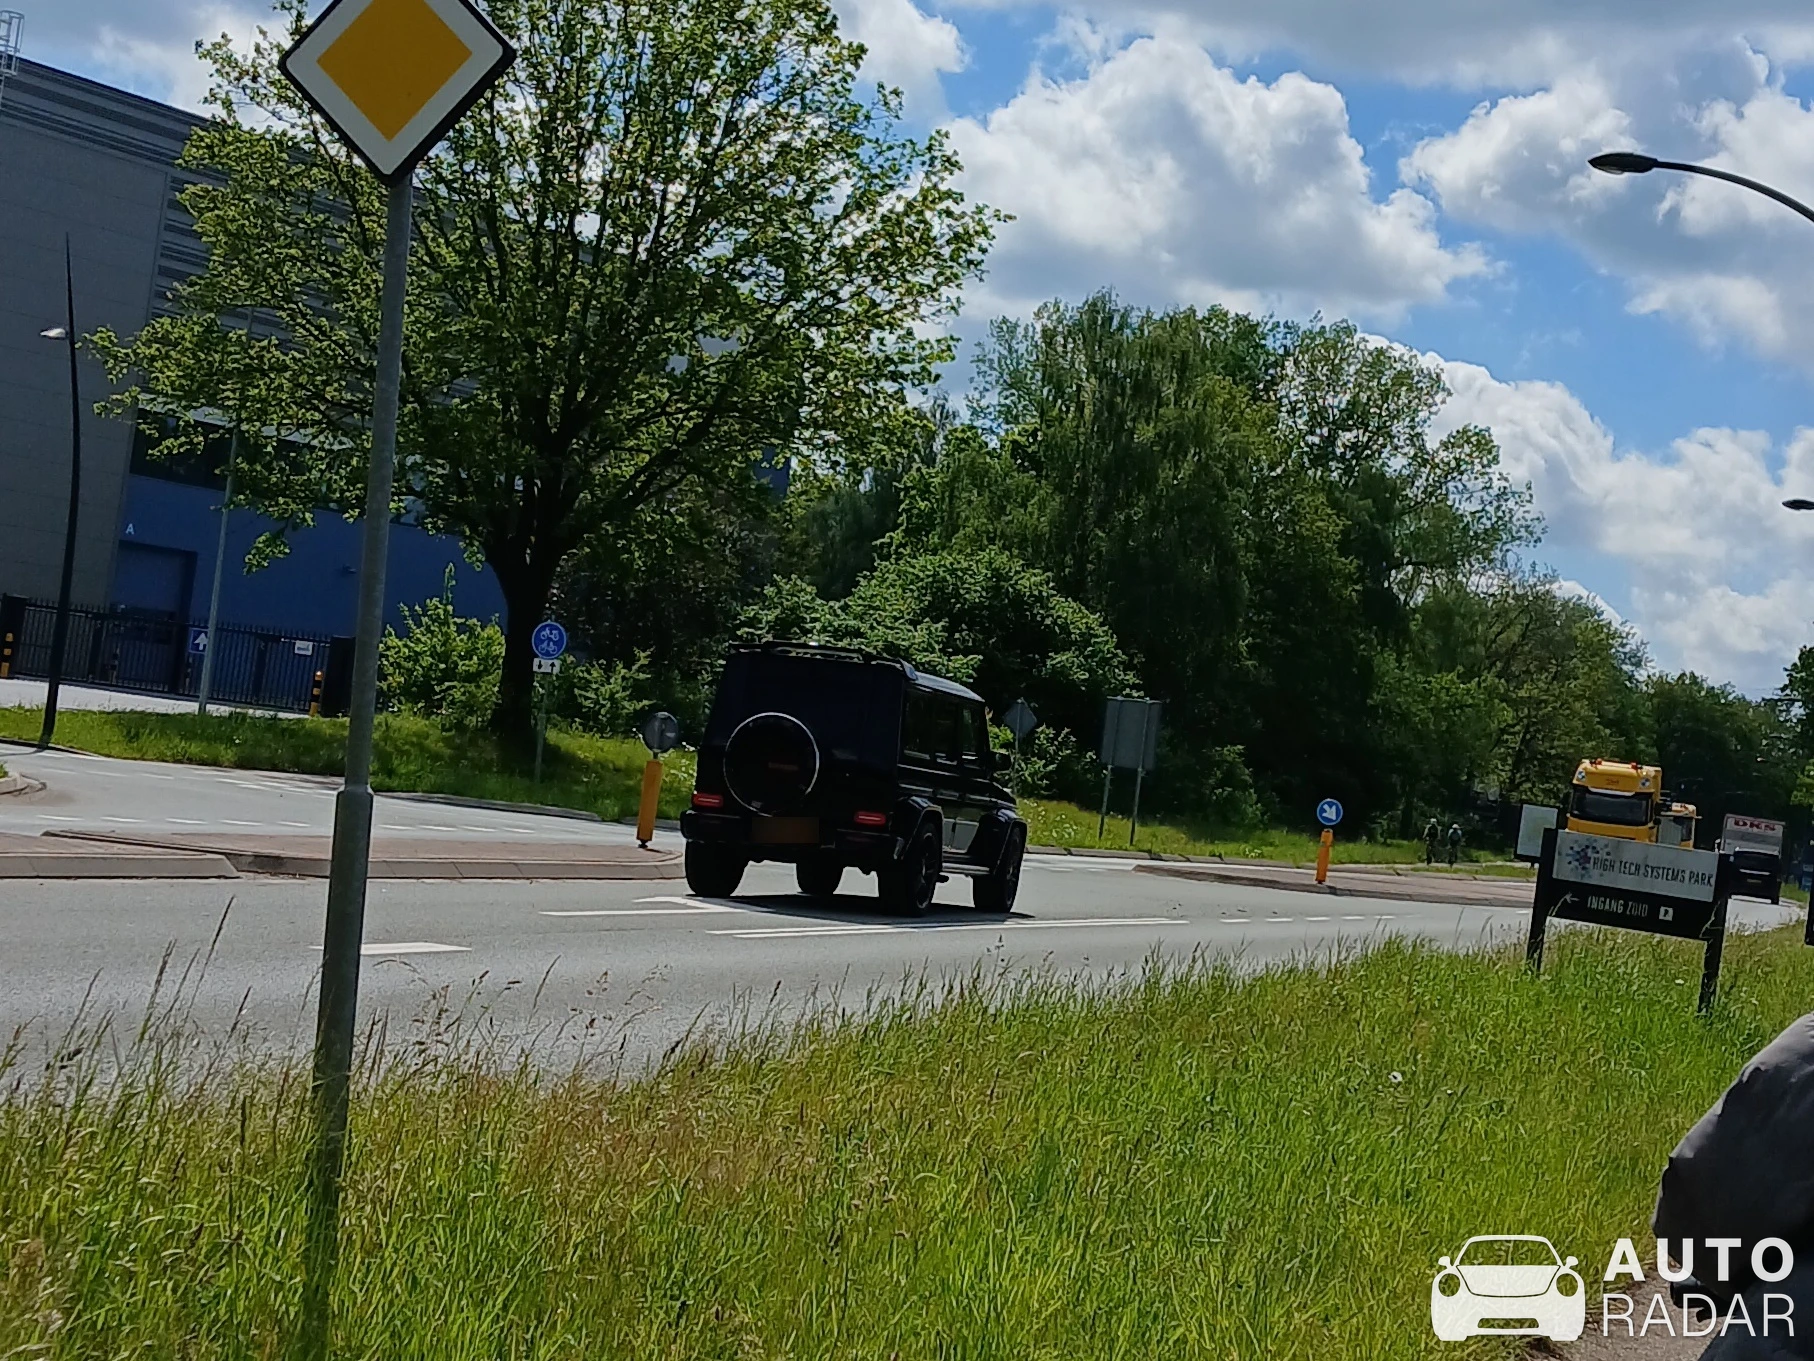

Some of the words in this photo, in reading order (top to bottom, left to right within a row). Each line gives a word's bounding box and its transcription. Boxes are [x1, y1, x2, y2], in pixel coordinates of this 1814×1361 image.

[125, 523, 134, 535] A
[1593, 857, 1615, 872] HIGH
[1619, 861, 1640, 876] TECH
[1643, 865, 1686, 883] SYSTEMS
[1689, 870, 1714, 888] PARK
[1587, 895, 1624, 914] INGANG
